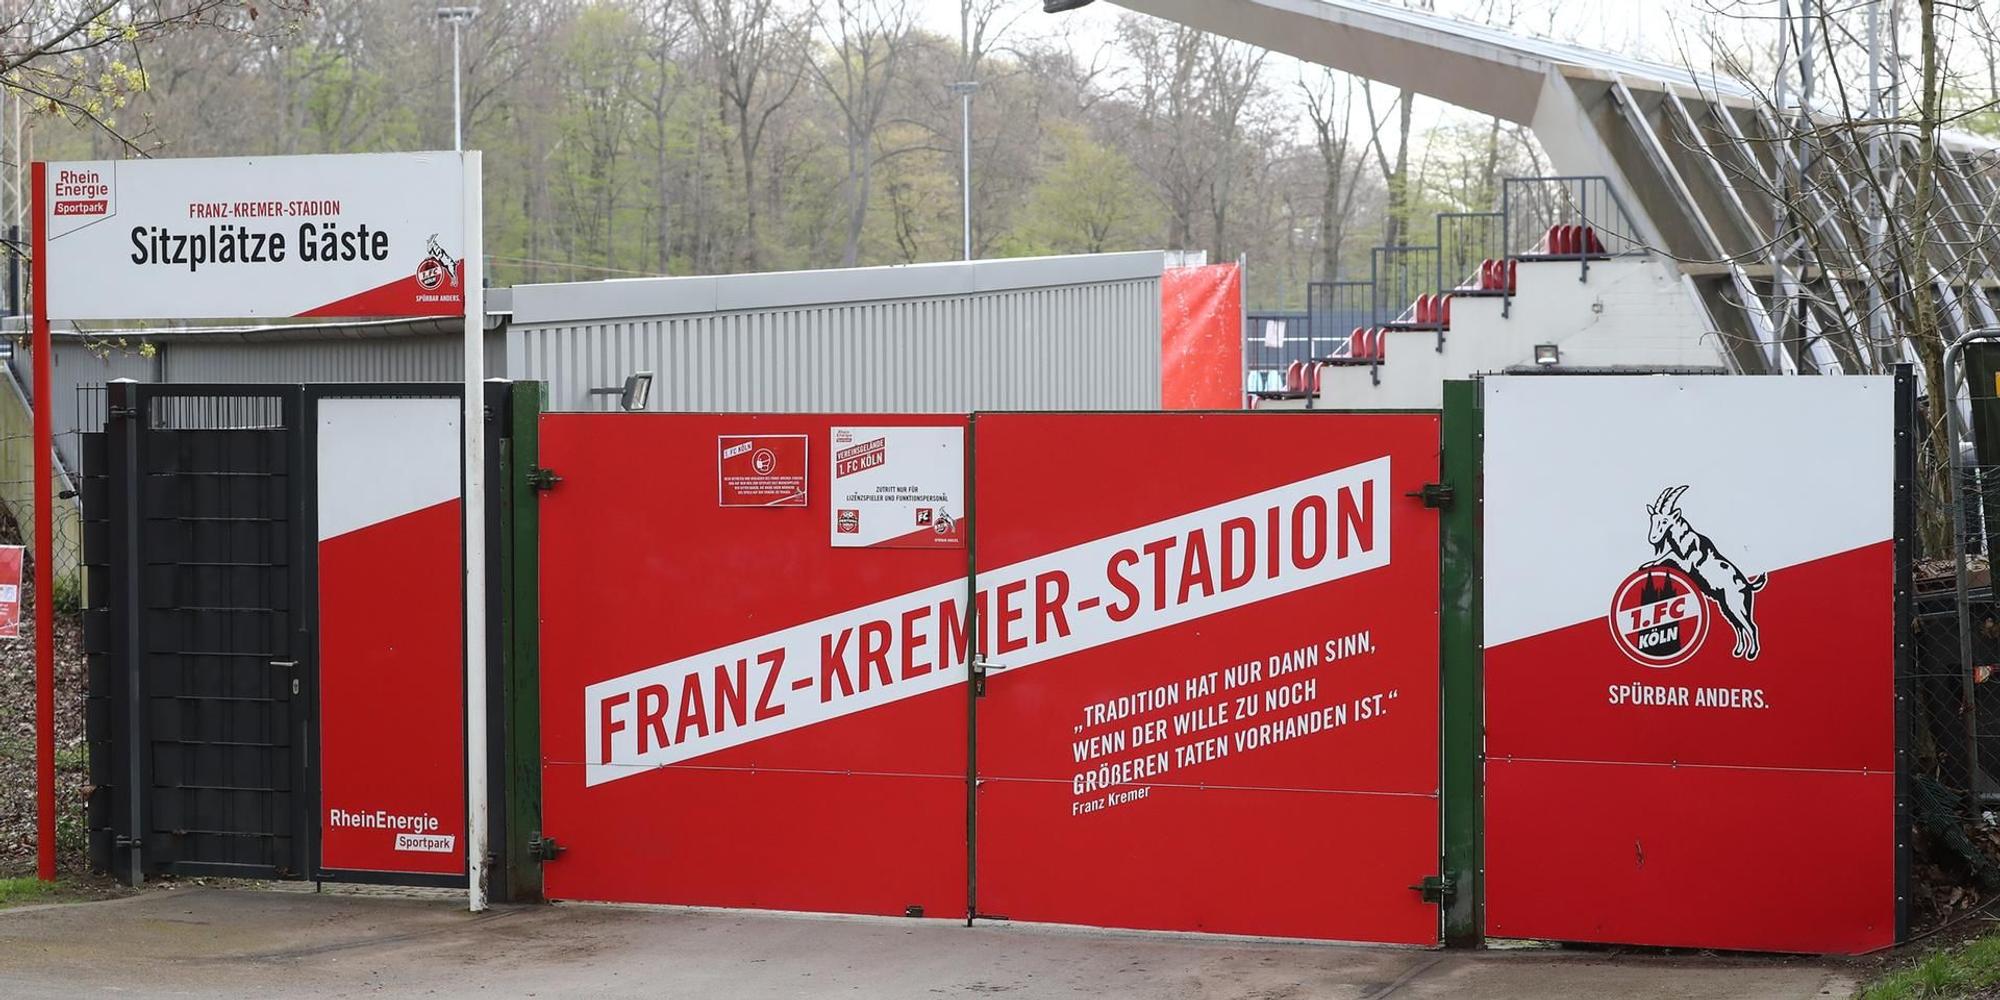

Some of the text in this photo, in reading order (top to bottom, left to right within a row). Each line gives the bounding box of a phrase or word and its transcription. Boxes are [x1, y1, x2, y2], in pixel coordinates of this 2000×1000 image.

[61, 170, 99, 184] Rhein
[56, 183, 108, 199] Energie
[57, 202, 104, 215] Sportpark
[189, 200, 340, 219] FRANZ-KREMER-STADION
[131, 222, 389, 272] Sitzplätze Gäste
[838, 439, 884, 460] VEREINSGELÄNDE
[847, 460, 858, 473] FC
[861, 451, 883, 469] KÖLN
[846, 494, 949, 502] LIZENZSPIELER UND FUNKTIONSPERSONAL
[909, 485, 919, 493] FÜR
[601, 480, 1374, 766] FRANZ-KREMER-STADION
[1638, 626, 1679, 650] KÖLN
[1186, 672, 1218, 701] HAT
[1224, 660, 1263, 690] NUR
[1269, 644, 1319, 678] DANN
[1325, 630, 1377, 663] SINN,
[1608, 682, 1769, 709] SPÜRBAR ANDERS.
[1072, 679, 1317, 763] WENN DER WILLE ZU NOCH
[1175, 735, 1229, 769] TATEN
[1234, 704, 1347, 752] VORHANDEN
[1072, 786, 1152, 816] Franz Kremer
[330, 808, 439, 833] RheinEnergie
[399, 836, 450, 850] Sportpark
